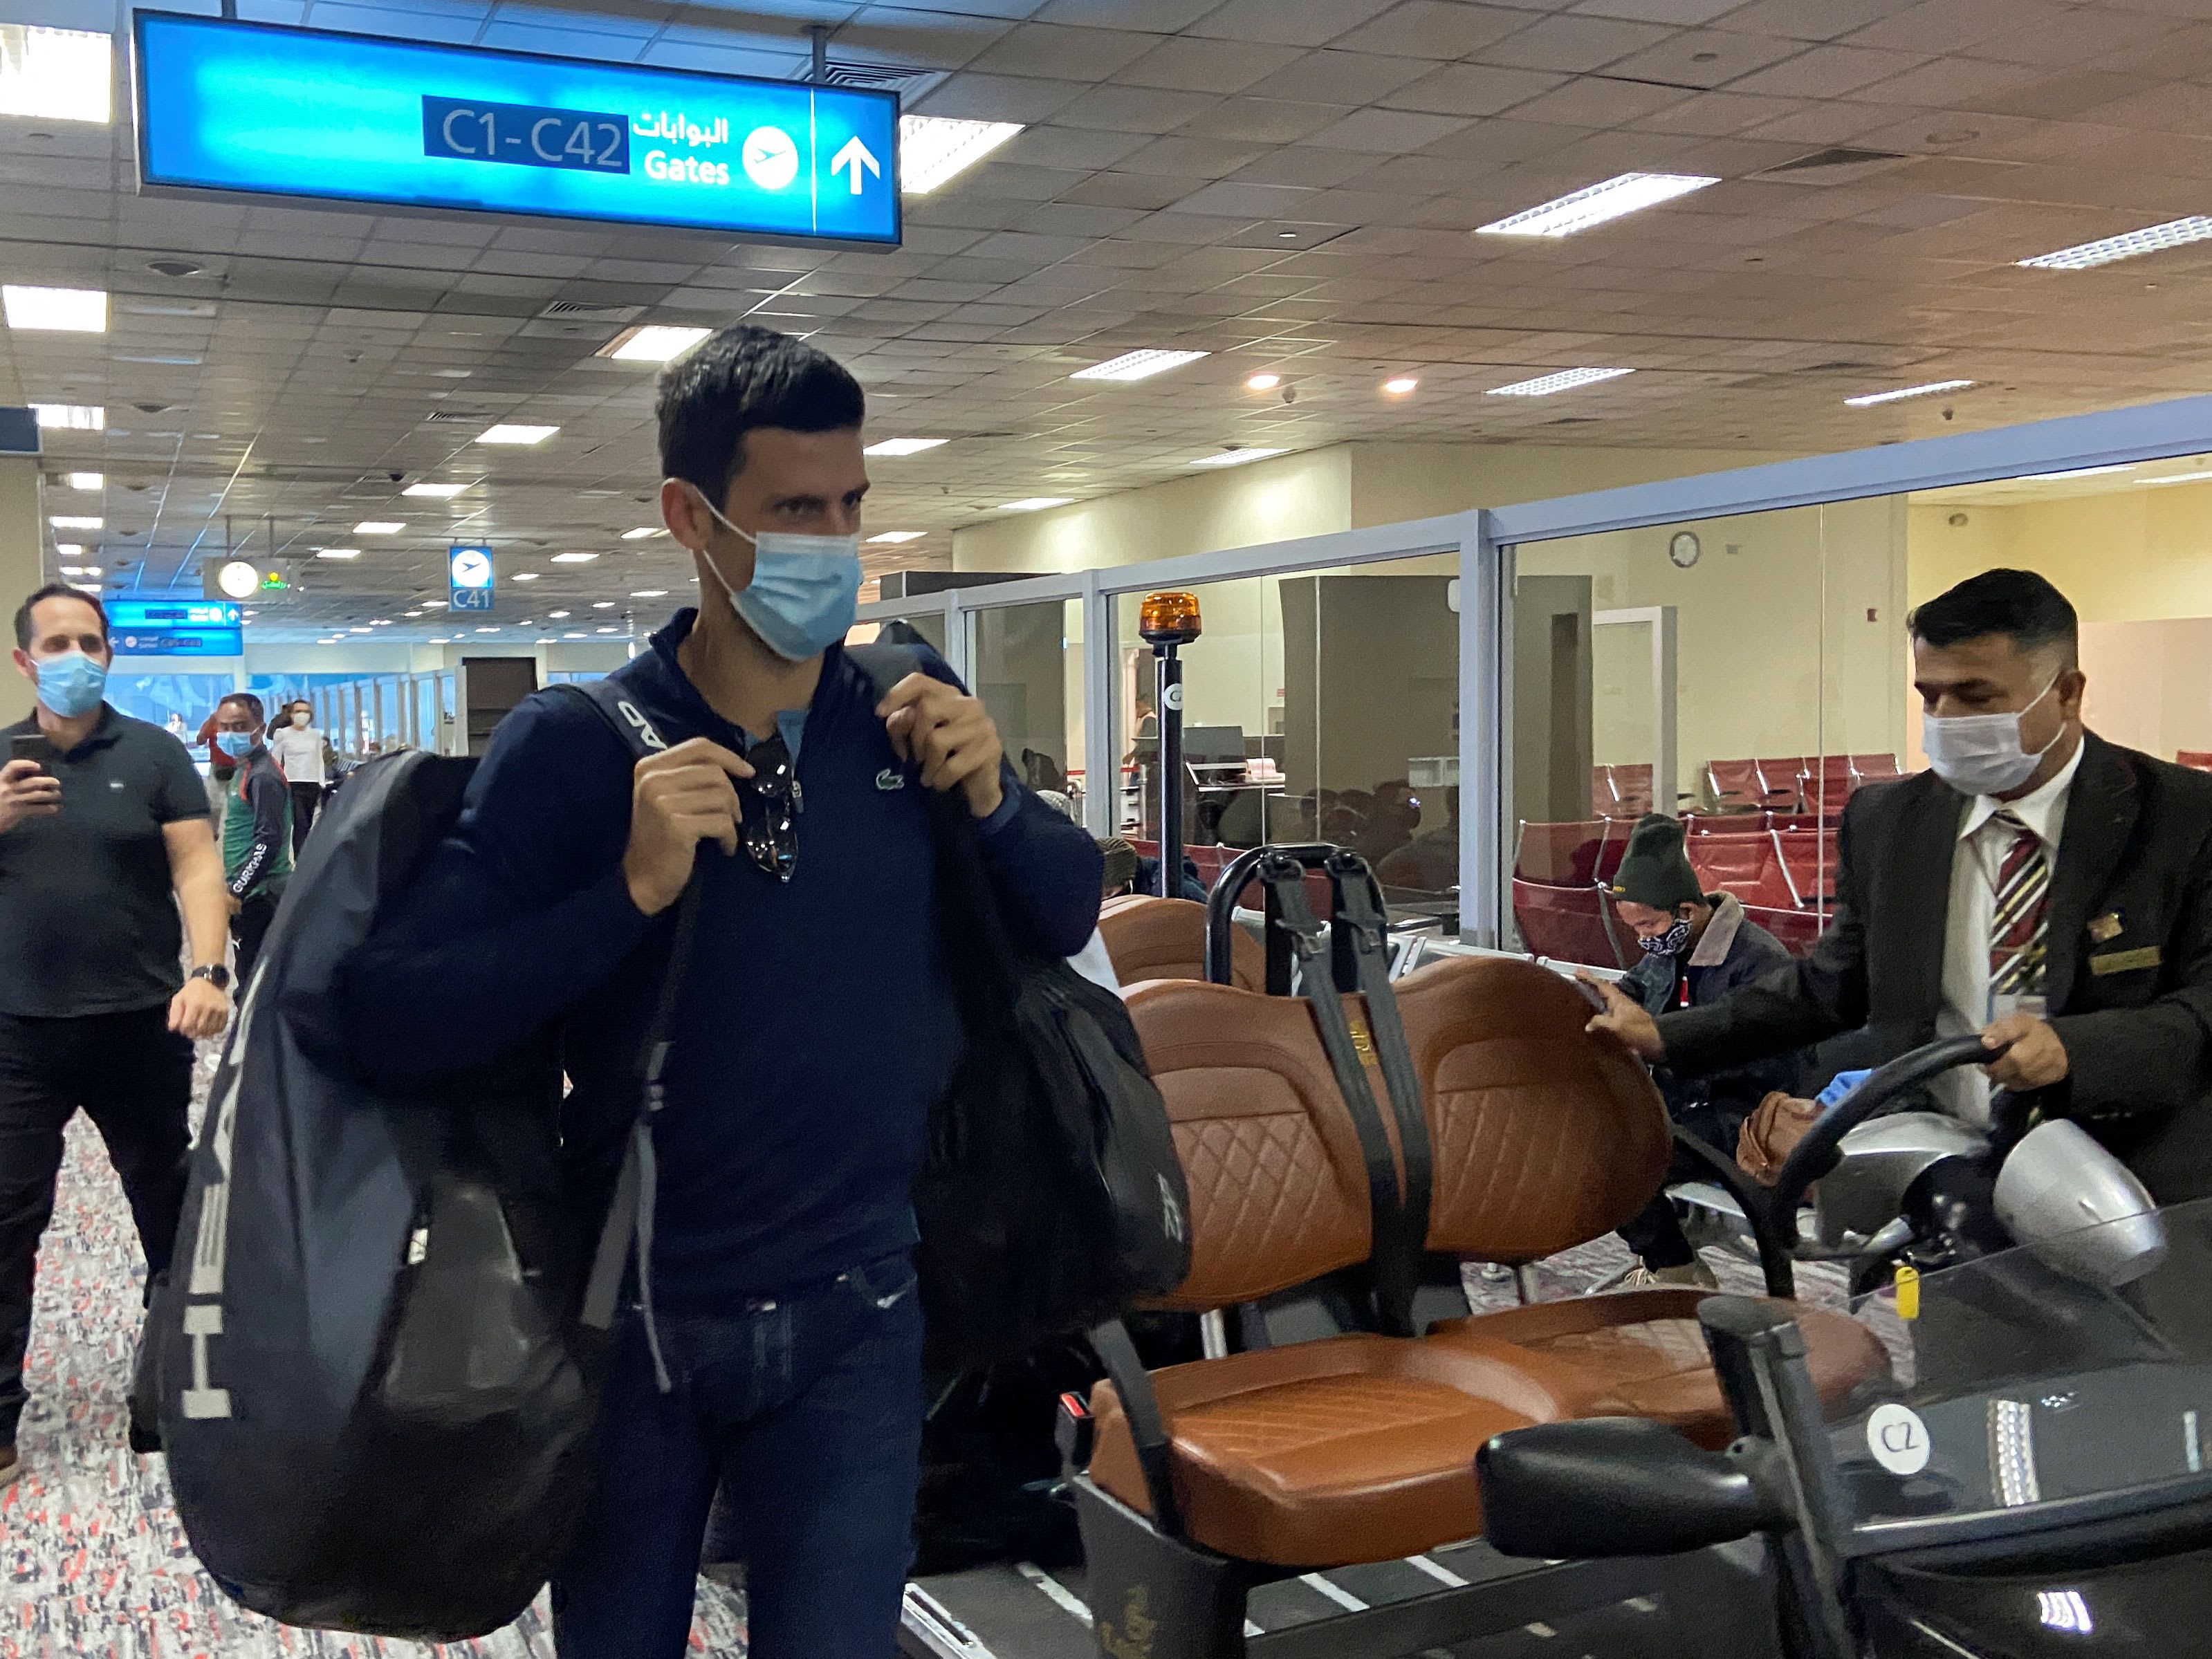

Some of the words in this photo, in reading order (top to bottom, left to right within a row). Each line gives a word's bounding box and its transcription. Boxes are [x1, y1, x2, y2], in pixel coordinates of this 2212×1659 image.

[632, 111, 729, 148] البوابات
[644, 149, 730, 185] Gates
[452, 589, 490, 608] C41
[232, 842, 268, 893] GURKHAS
